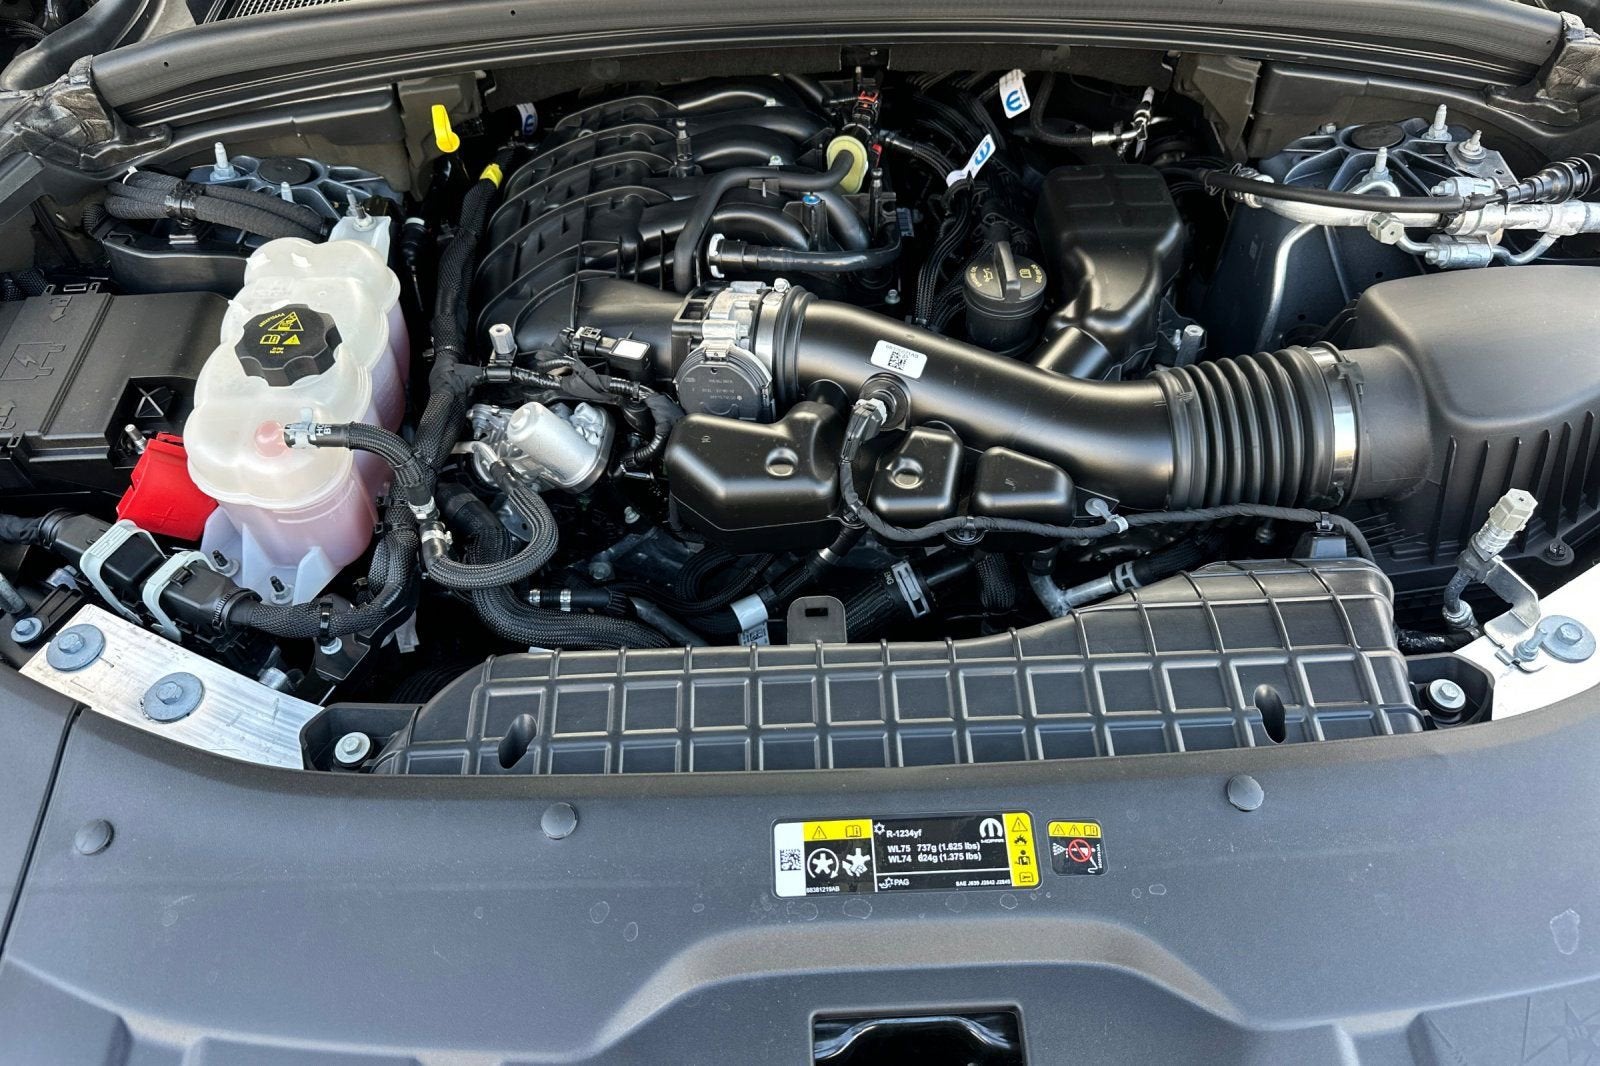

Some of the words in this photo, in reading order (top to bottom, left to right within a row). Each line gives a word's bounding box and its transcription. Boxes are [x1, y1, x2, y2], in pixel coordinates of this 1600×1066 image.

[884, 571, 894, 585] ENG
[886, 829, 922, 838] R-1234yf
[887, 844, 911, 853] WL75
[917, 843, 937, 853] 737g
[938, 843, 963, 852] (1.625
[964, 842, 981, 852] lbs)
[888, 854, 912, 863] WL74
[918, 853, 938, 863] 624g
[939, 853, 965, 862] (1.375
[965, 852, 982, 862] lbs)
[893, 878, 910, 886] PAG
